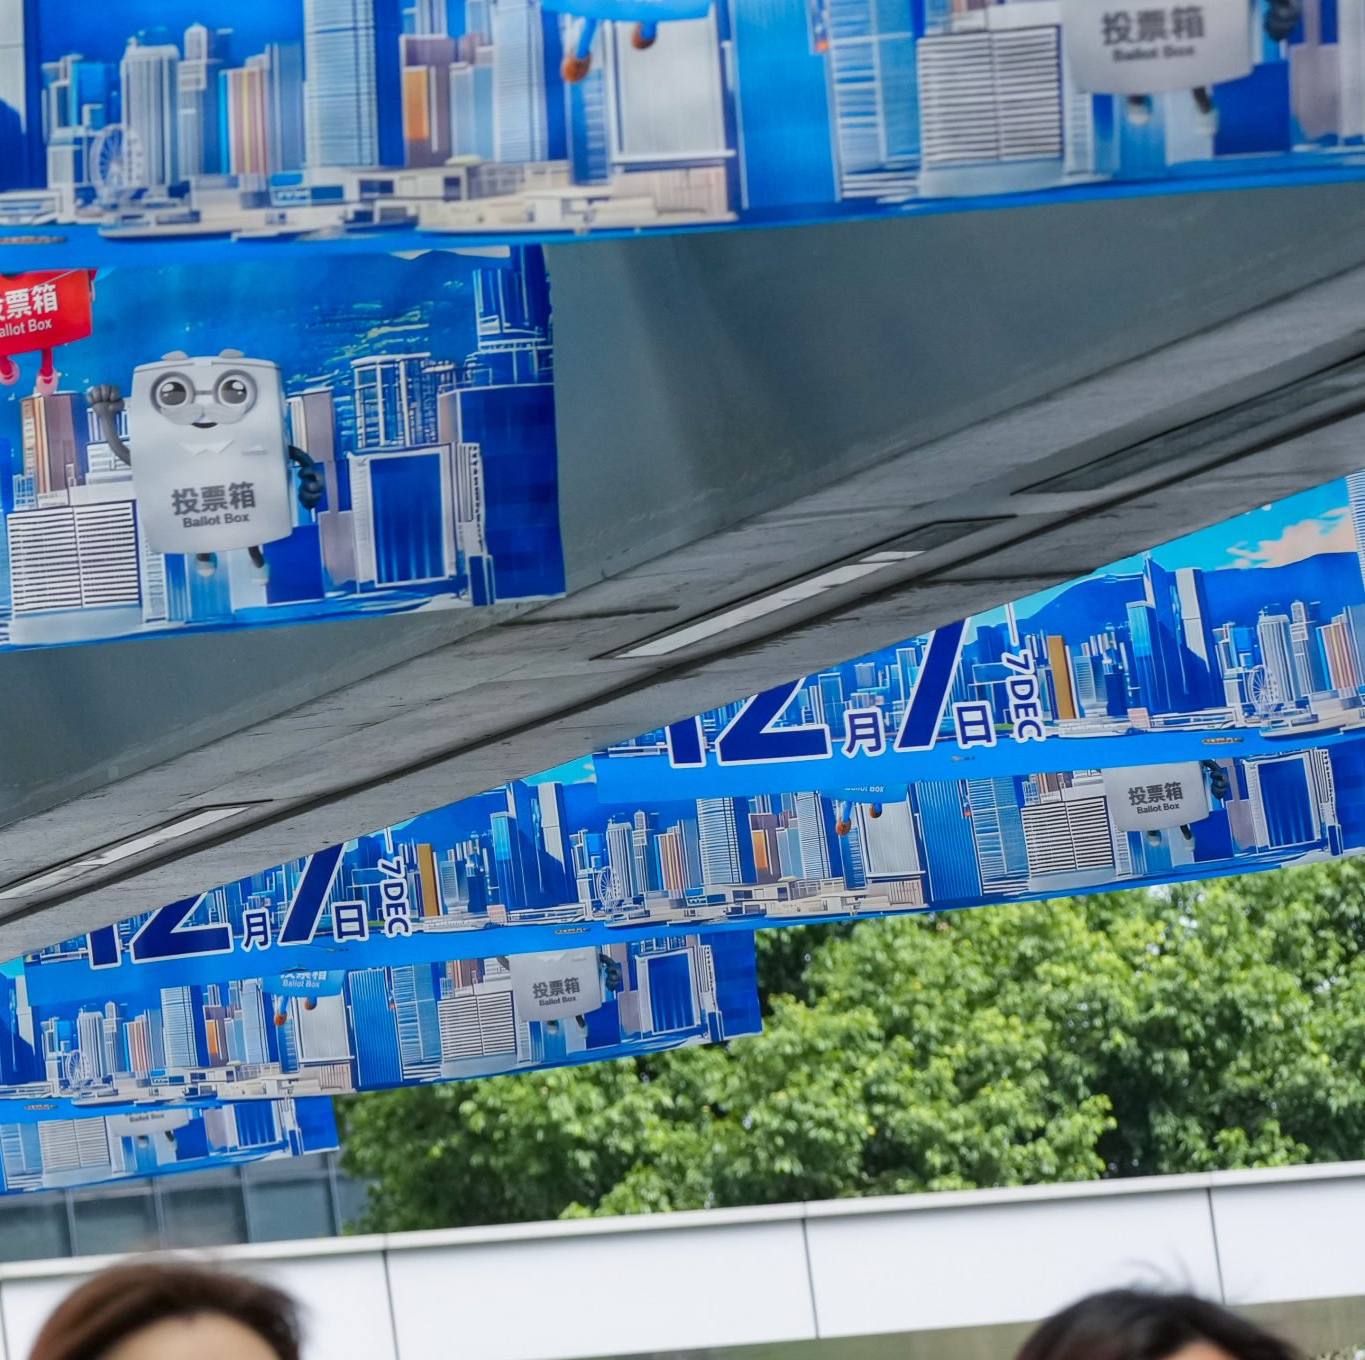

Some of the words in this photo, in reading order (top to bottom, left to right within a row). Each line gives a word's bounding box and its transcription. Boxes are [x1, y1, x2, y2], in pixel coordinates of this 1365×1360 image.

[28, 318, 53, 333] Box
[171, 482, 256, 516] 投票箱
[182, 514, 221, 529] Ballot
[223, 511, 250, 525] Box
[1128, 781, 1183, 806] 投票箱
[1136, 803, 1161, 816] Ballot
[1163, 800, 1181, 812] Box
[532, 977, 581, 999] 投票箱
